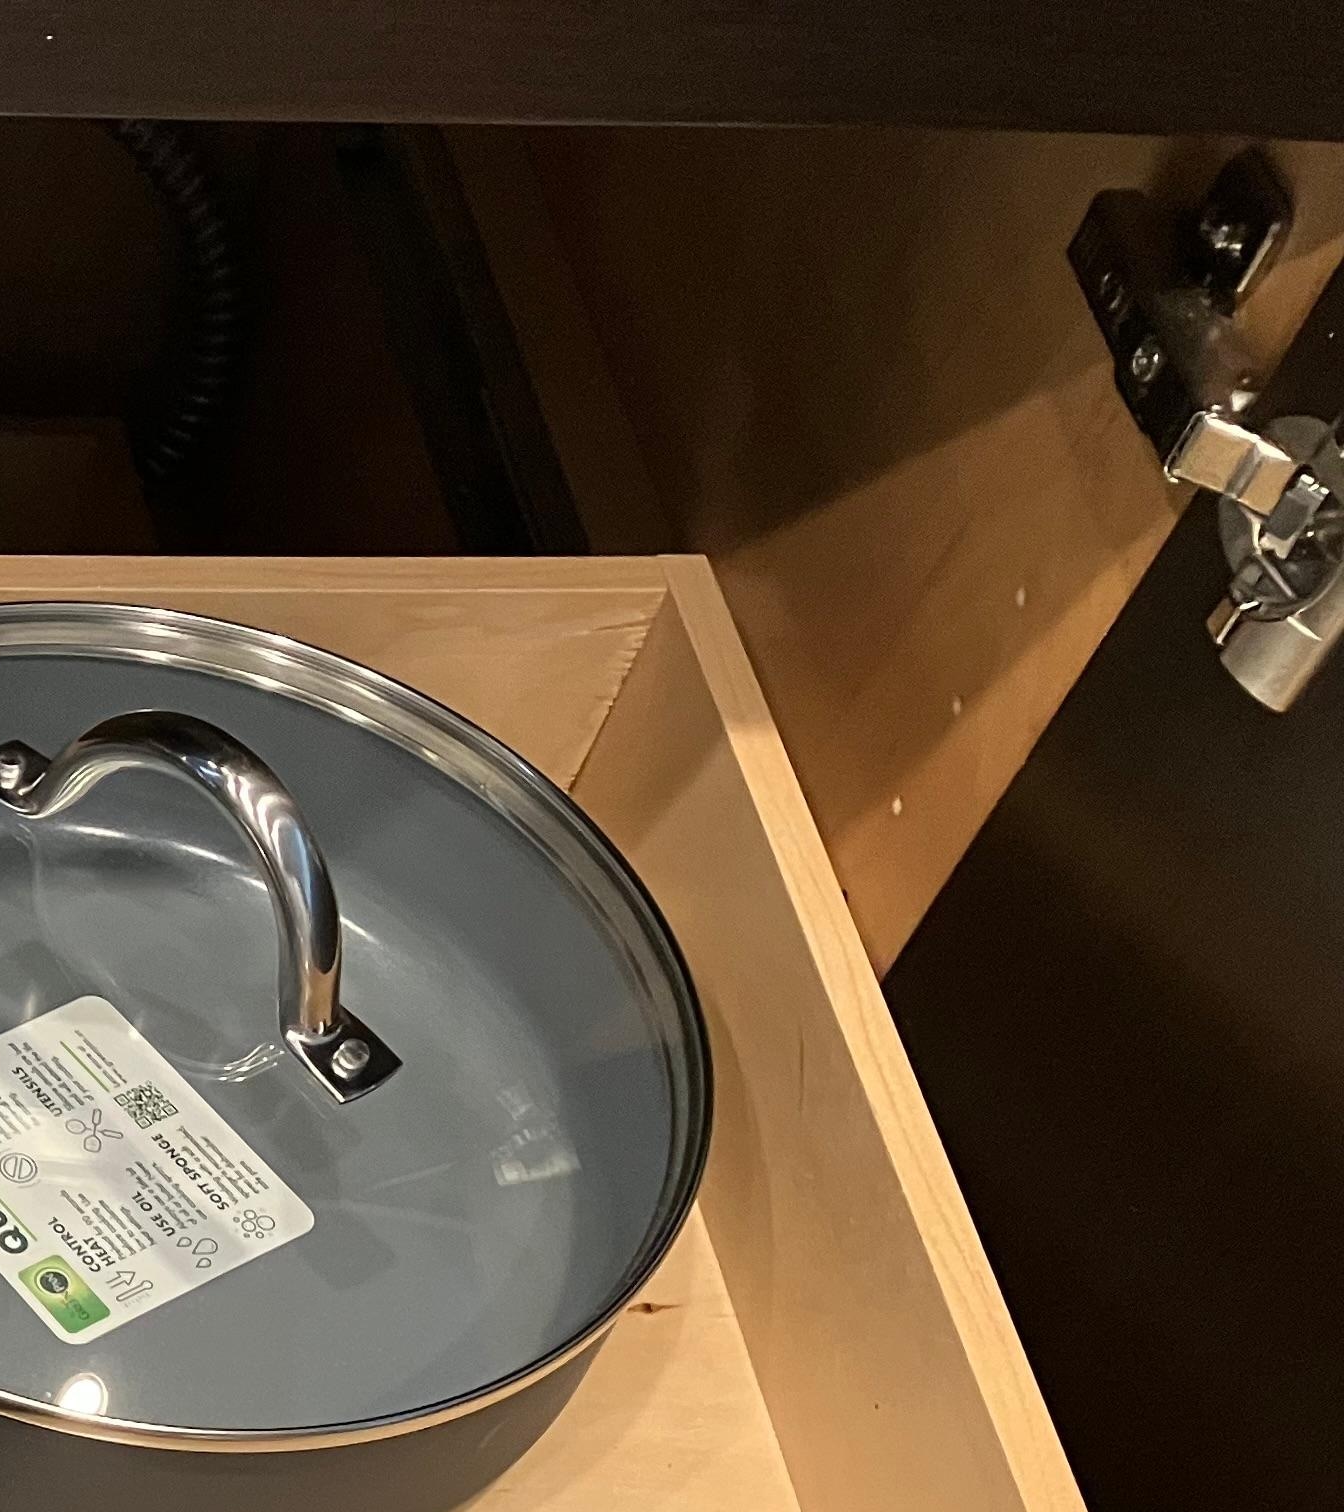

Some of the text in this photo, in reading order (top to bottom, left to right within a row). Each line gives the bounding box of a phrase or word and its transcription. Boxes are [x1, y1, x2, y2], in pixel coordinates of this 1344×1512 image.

[11, 1066, 62, 1116] UTENSILS
[151, 1133, 201, 1180] SPONGE
[131, 1190, 175, 1236] USE OIL
[196, 1182, 229, 1210] SOFT
[47, 1216, 101, 1272] CONTROL
[82, 1237, 115, 1266] HEAT
